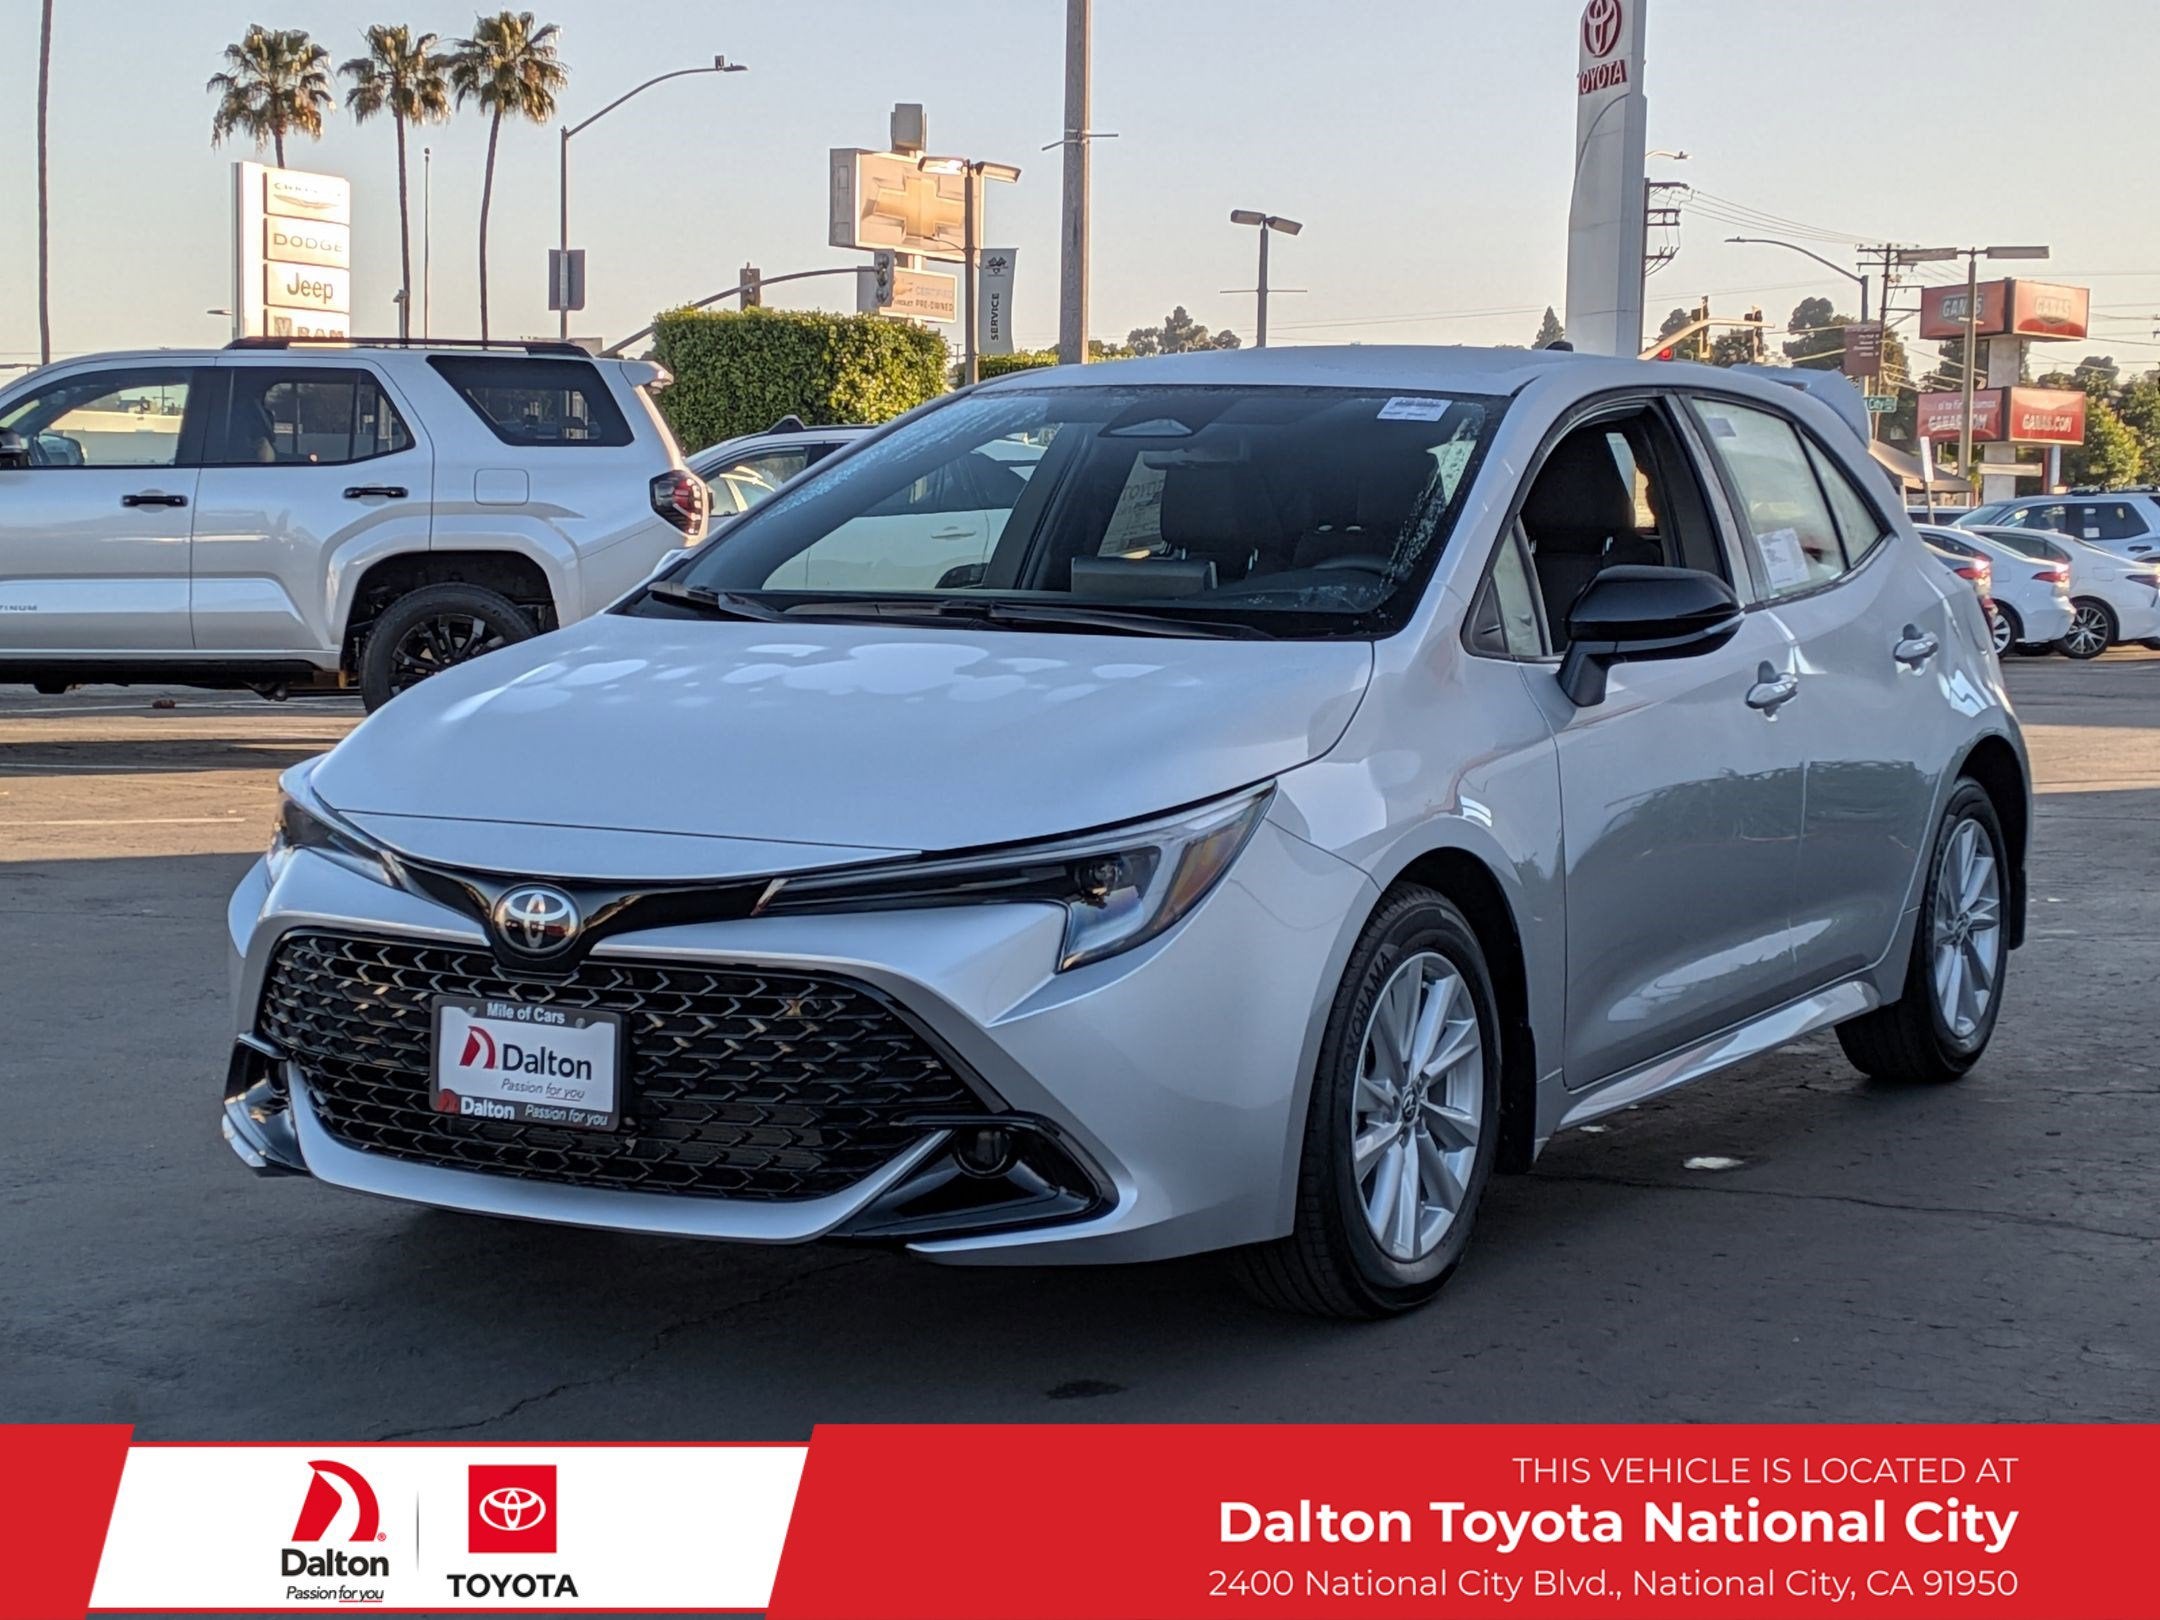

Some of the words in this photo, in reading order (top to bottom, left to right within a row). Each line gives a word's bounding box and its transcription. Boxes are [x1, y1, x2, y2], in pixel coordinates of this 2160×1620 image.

[273, 232, 343, 252] DODGE
[287, 272, 334, 305] Jeep
[915, 299, 953, 312] PRE-OWNED
[990, 293, 1000, 341] SERVICE
[486, 1002, 515, 1019] Mile
[517, 1007, 530, 1020] of
[533, 1007, 566, 1025] Cars
[1340, 951, 1391, 1089] YOKOHAMA
[502, 1043, 592, 1081] Dalton
[501, 1078, 543, 1094] Passion
[545, 1082, 563, 1099] for
[563, 1088, 586, 1101] you
[460, 1097, 516, 1119] Dalton
[525, 1104, 566, 1120] Passion
[567, 1107, 586, 1124] for
[586, 1112, 609, 1127] you
